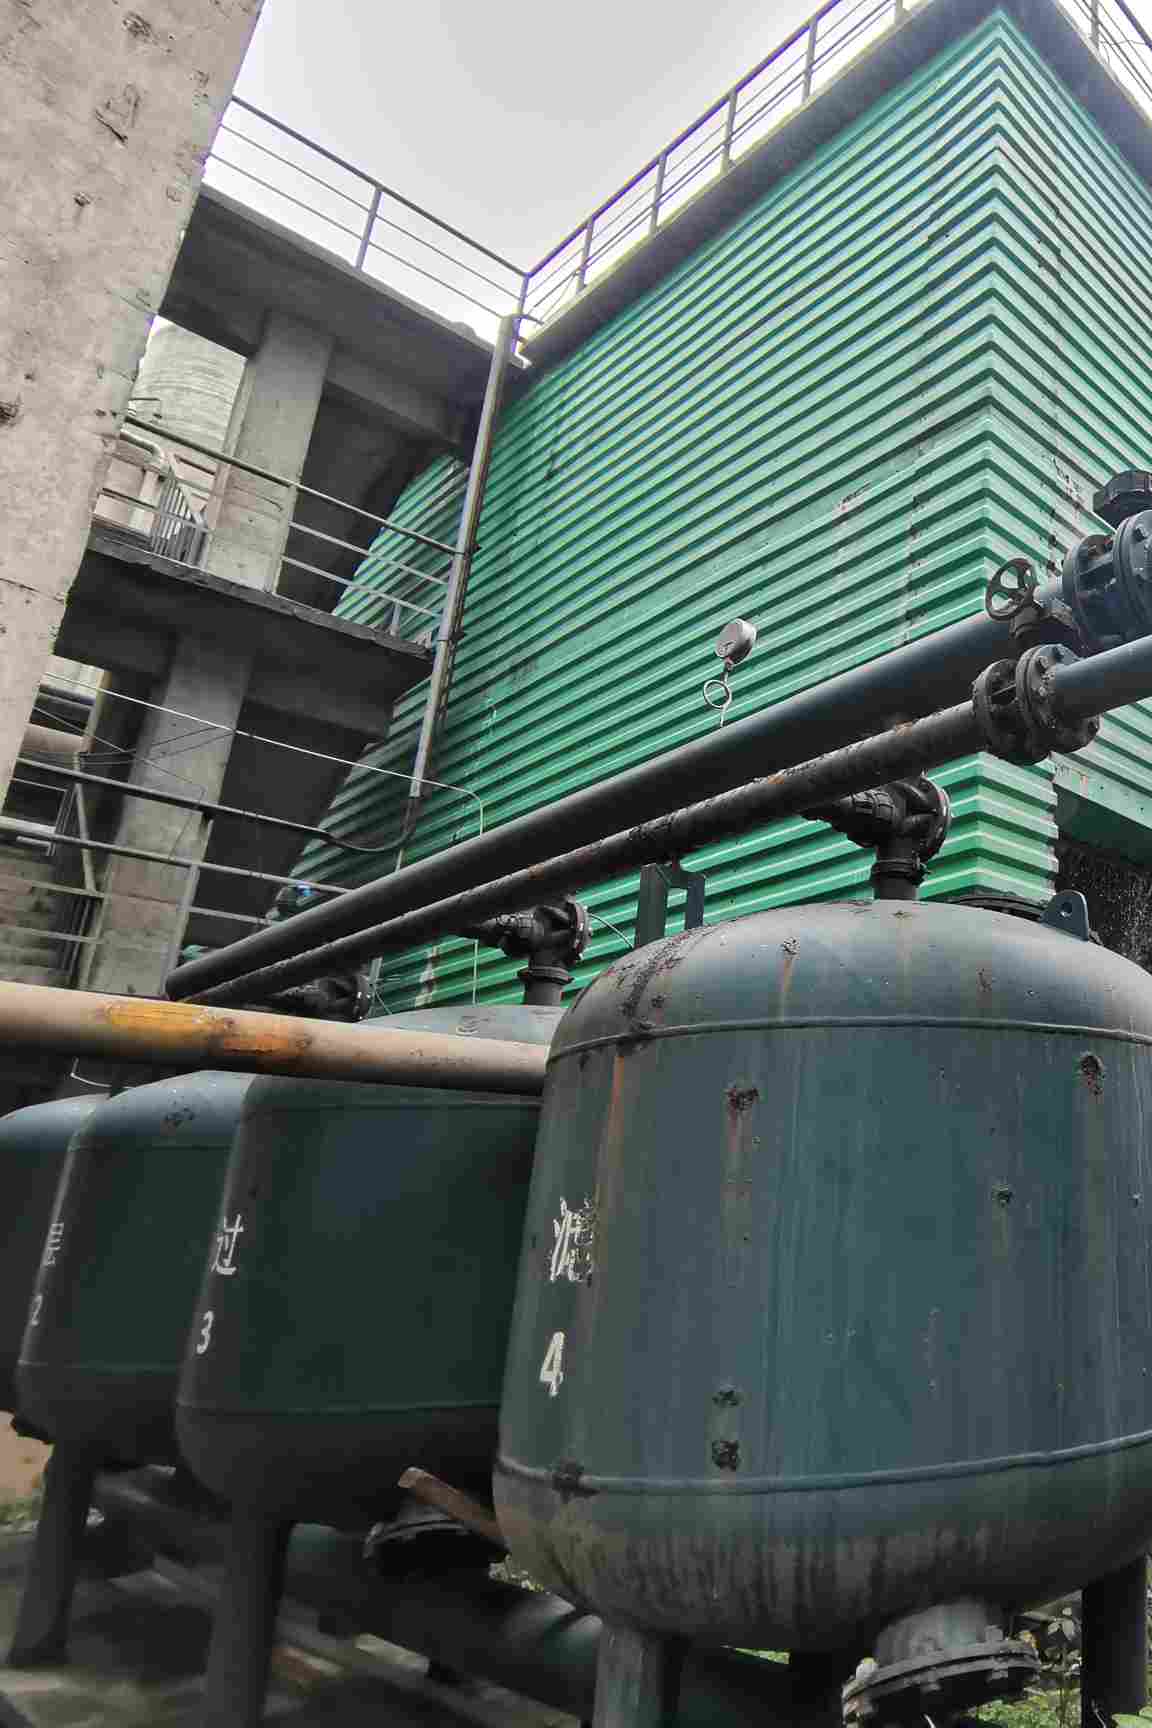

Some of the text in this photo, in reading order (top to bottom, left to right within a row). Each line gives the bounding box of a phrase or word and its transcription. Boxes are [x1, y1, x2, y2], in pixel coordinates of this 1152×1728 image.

[210, 1213, 244, 1276] 过
[196, 1310, 214, 1355] 3
[539, 1331, 565, 1397] 4
